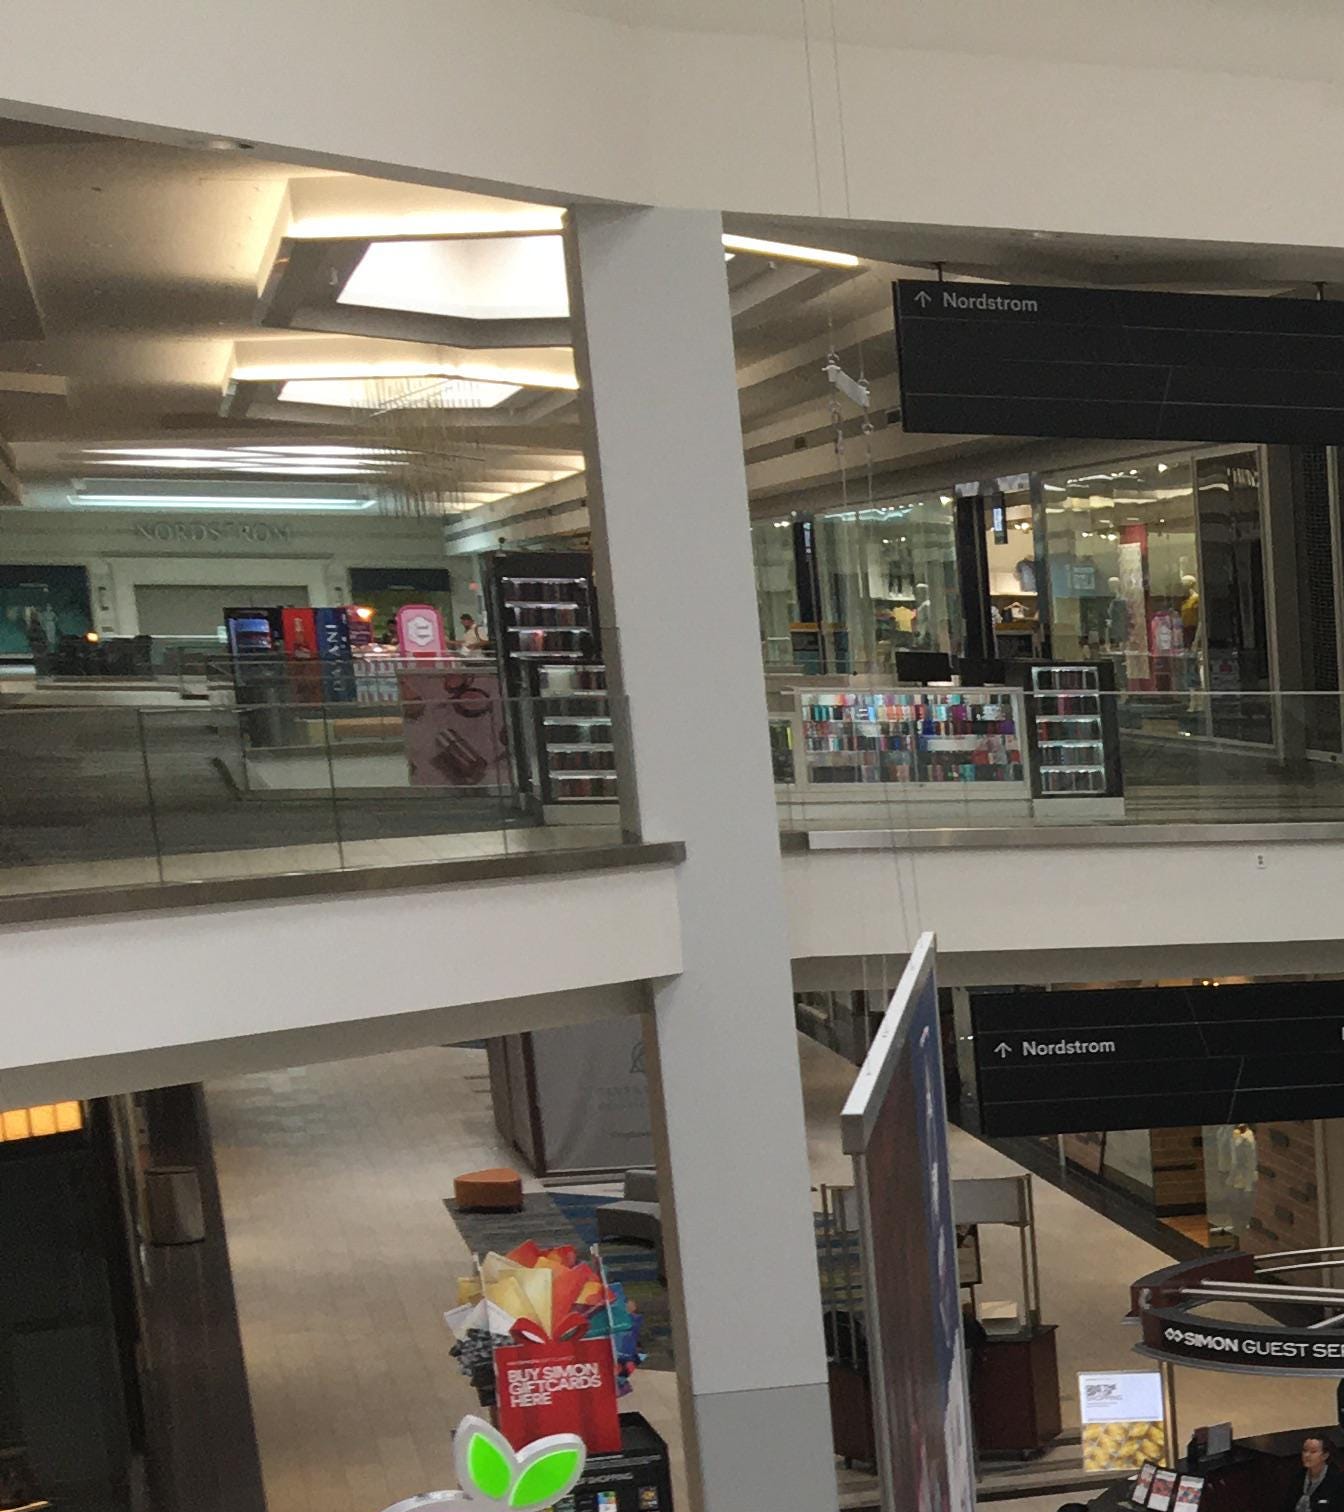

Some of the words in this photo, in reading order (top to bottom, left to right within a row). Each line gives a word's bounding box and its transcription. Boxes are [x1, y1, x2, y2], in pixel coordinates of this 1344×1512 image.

[943, 291, 1038, 312] Nordstrom
[1022, 1038, 1116, 1057] Nordstrom
[1184, 1333, 1239, 1352] SIMON
[1242, 1339, 1309, 1357] GUEST
[507, 1367, 540, 1383] BUY
[542, 1362, 599, 1380] SIMON
[508, 1375, 602, 1395] GIFTCARDS
[510, 1391, 553, 1408] HERE
